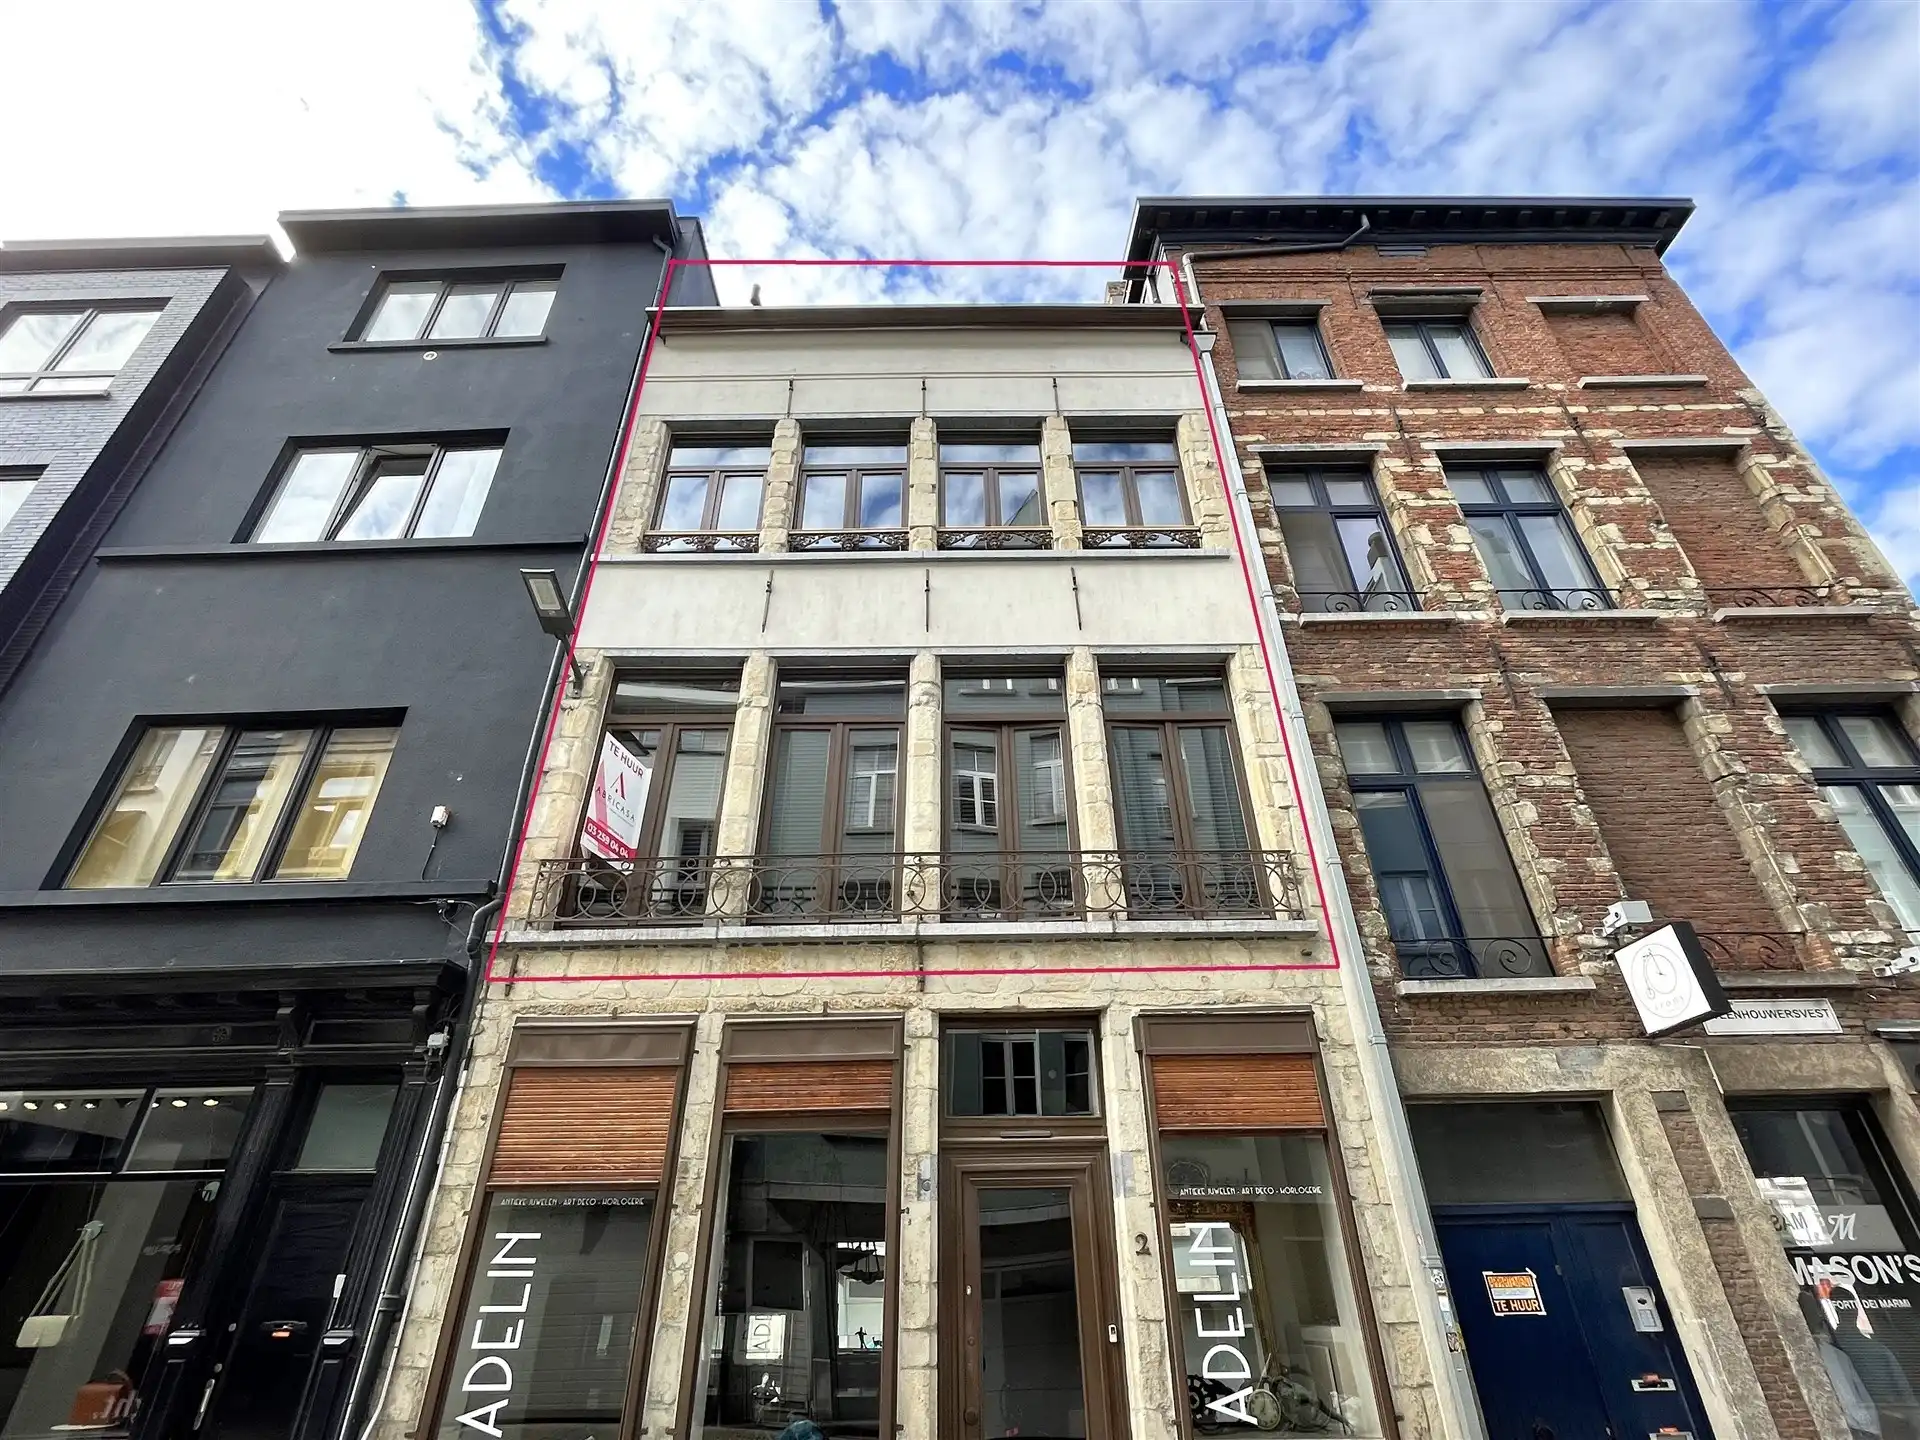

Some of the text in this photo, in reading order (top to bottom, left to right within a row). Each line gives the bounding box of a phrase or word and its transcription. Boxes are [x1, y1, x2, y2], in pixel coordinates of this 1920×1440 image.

[609, 741, 644, 779] TE HUUR
[595, 786, 636, 821] ABRICASA
[587, 823, 598, 836] 03
[597, 831, 610, 844] 259
[610, 841, 619, 853] 04
[563, 1198, 576, 1206] ART
[577, 1198, 597, 1206] DECO
[1207, 1186, 1236, 1196] JUWELEN
[1241, 1186, 1254, 1195] ART
[1255, 1186, 1275, 1195] DECO
[1135, 1232, 1151, 1256] 2
[1493, 1299, 1540, 1312] TE HUUR
[1832, 1298, 1912, 1310] FORT DEI MARMI
[455, 1232, 542, 1439] ADELIN
[1185, 1222, 1259, 1427] ADELIN
